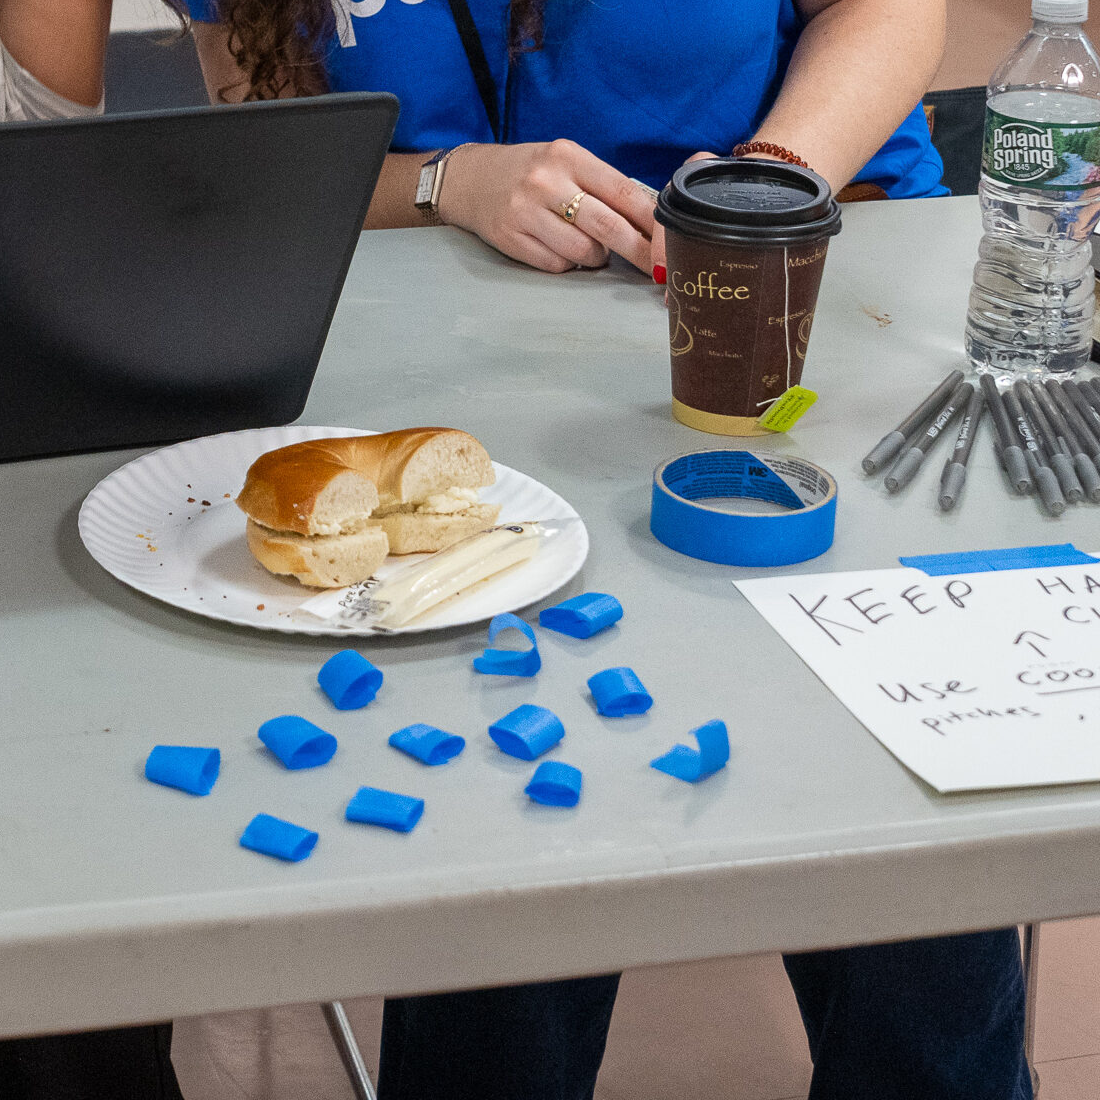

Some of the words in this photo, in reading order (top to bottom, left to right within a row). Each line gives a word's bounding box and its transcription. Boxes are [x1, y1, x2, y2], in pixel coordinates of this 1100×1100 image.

[993, 128, 1054, 149] Poland
[993, 147, 1055, 171] Spring
[1013, 163, 1030, 171] 1845
[671, 270, 750, 300] Coffee
[693, 325, 717, 339] Latte
[748, 465, 769, 478] 3M
[788, 580, 973, 646] KEEP
[921, 705, 1042, 736] pitches
